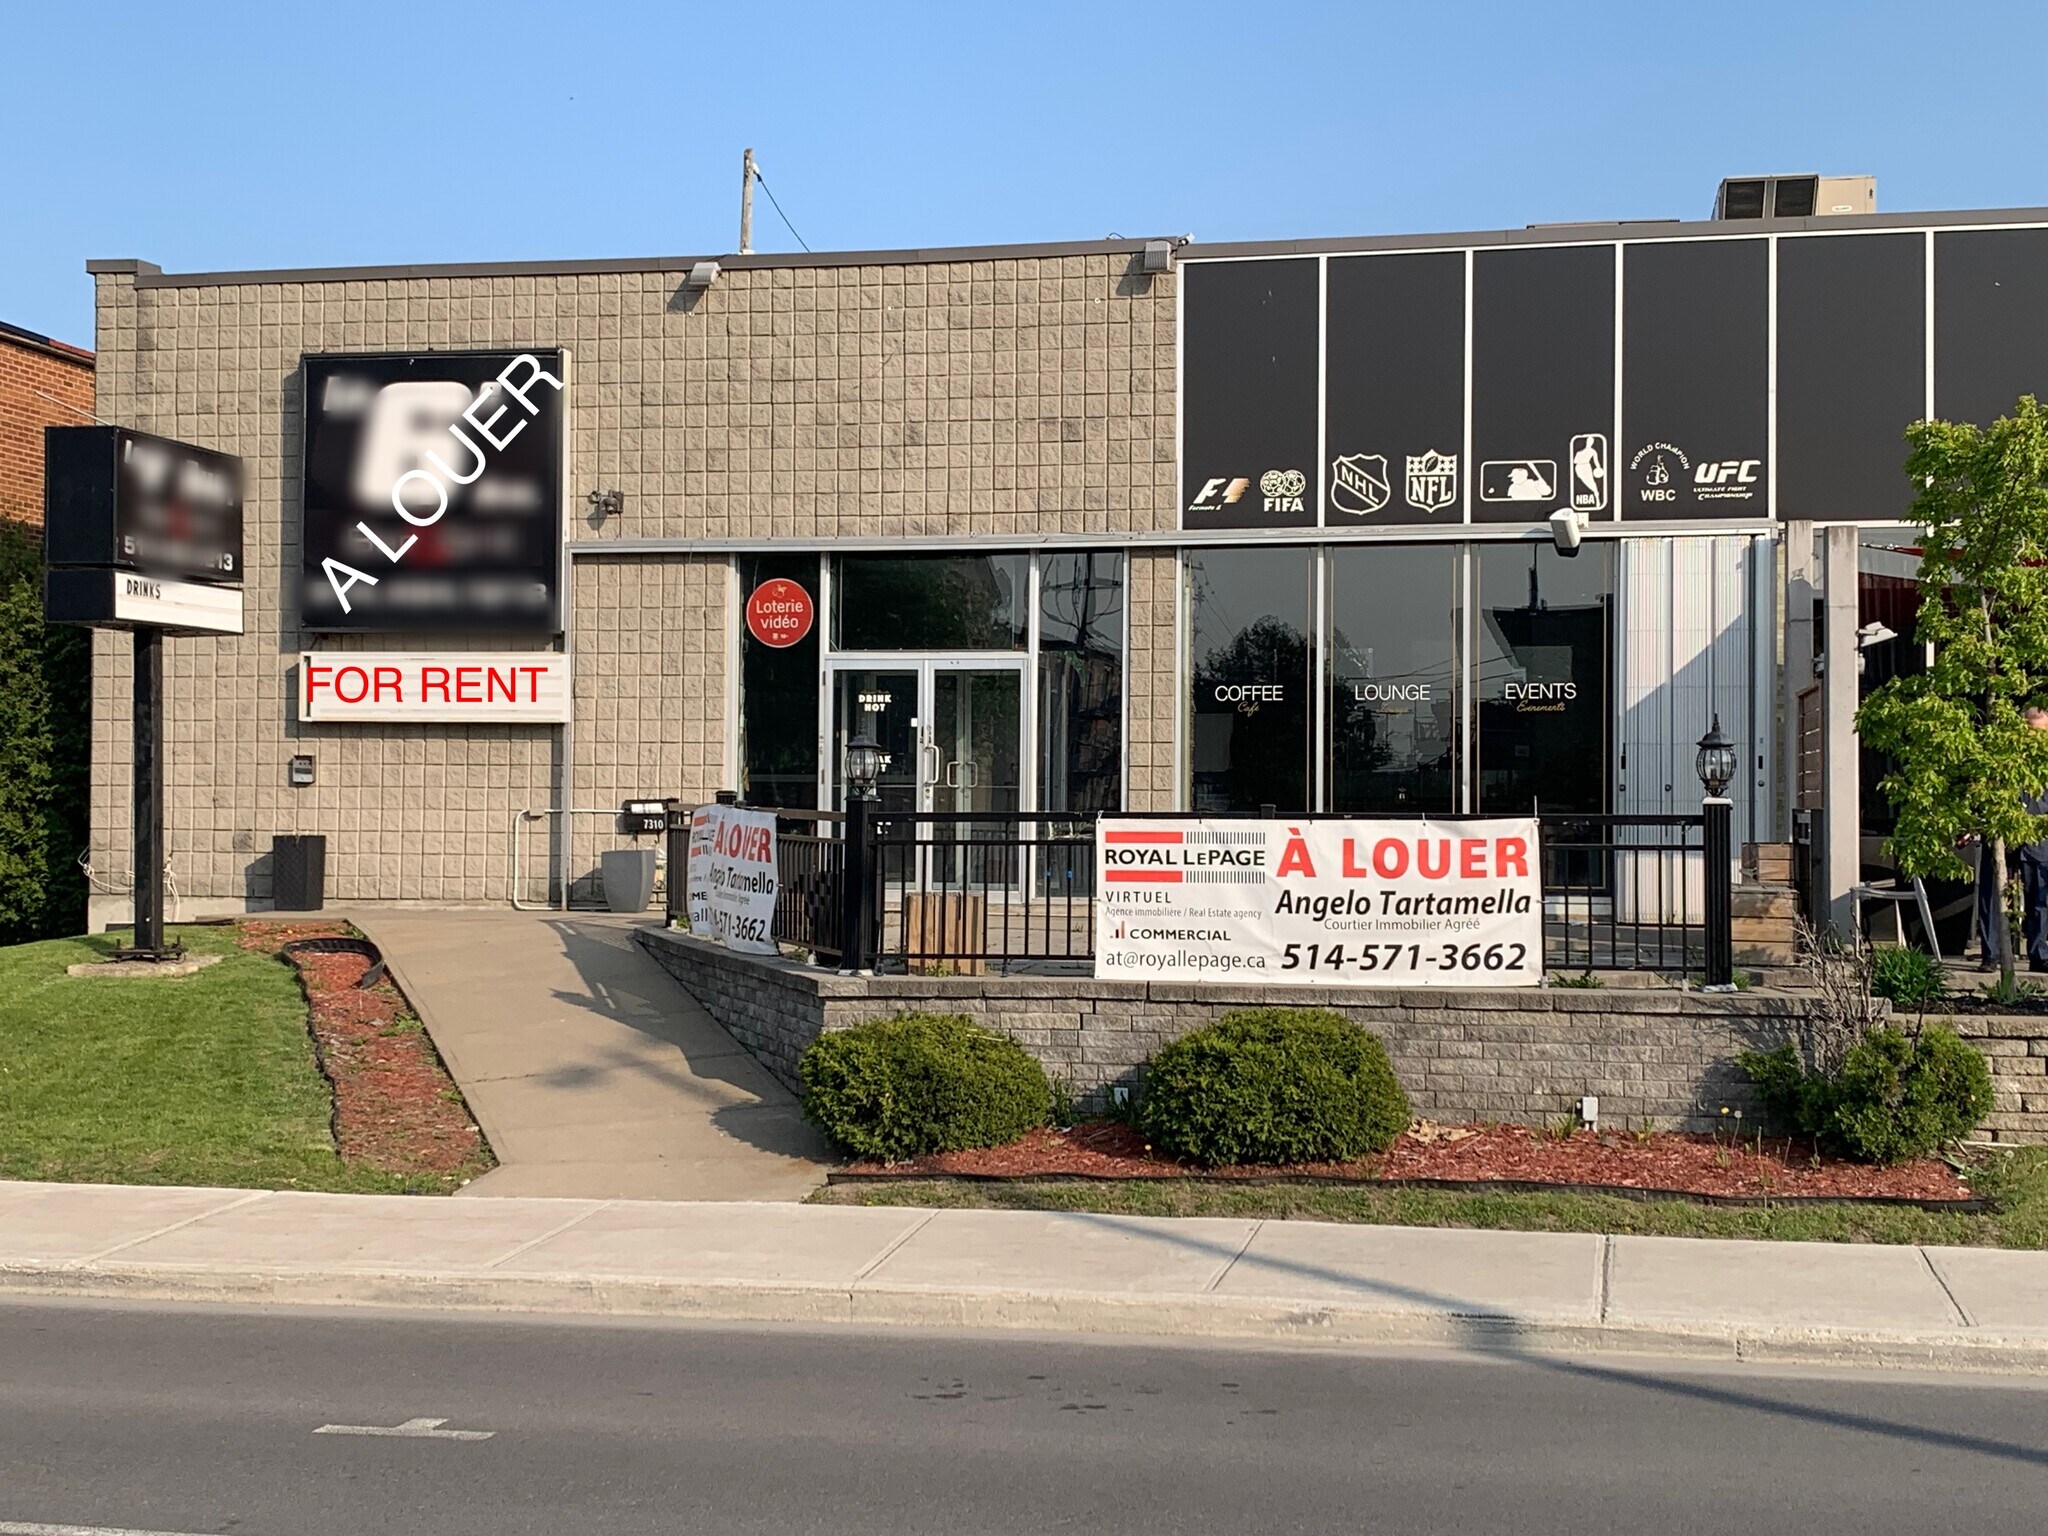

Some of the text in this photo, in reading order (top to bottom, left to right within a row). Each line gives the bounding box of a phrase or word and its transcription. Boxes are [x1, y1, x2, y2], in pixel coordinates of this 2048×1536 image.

[1630, 442, 1690, 471] WORLD CHAMPION
[1694, 460, 1761, 483] UFC
[1341, 465, 1379, 503] NHL
[1410, 476, 1452, 505] NFL
[1576, 494, 1596, 505] NBA
[1641, 490, 1676, 501] WBC
[1264, 497, 1304, 512] FIFA
[126, 579, 161, 600] DRINKS
[756, 599, 803, 614] Loterie
[760, 615, 799, 629] vidéo
[858, 694, 892, 703] DRINK
[1215, 685, 1283, 702] COFFEE
[1354, 684, 1431, 701] LOUNGE
[1505, 683, 1577, 699] EVENTS
[643, 819, 664, 829] 7310
[1105, 849, 1177, 865] ROYAL
[1276, 827, 1529, 879] À LOUER
[1105, 891, 1172, 904] VIRTUEL
[1275, 888, 1531, 922] Angelo Tartamella
[1105, 906, 1133, 918] Agence
[1189, 907, 1206, 917] Real
[1208, 908, 1232, 918] Estate
[1233, 910, 1262, 920] agency
[708, 906, 766, 942] -571-3662
[1324, 918, 1480, 932] Courtier Immobilier Agréé
[1130, 929, 1231, 941] COMMERCIAL
[1106, 950, 1265, 972] at@royallepage.ca
[1281, 943, 1527, 972] 514-571-3662
